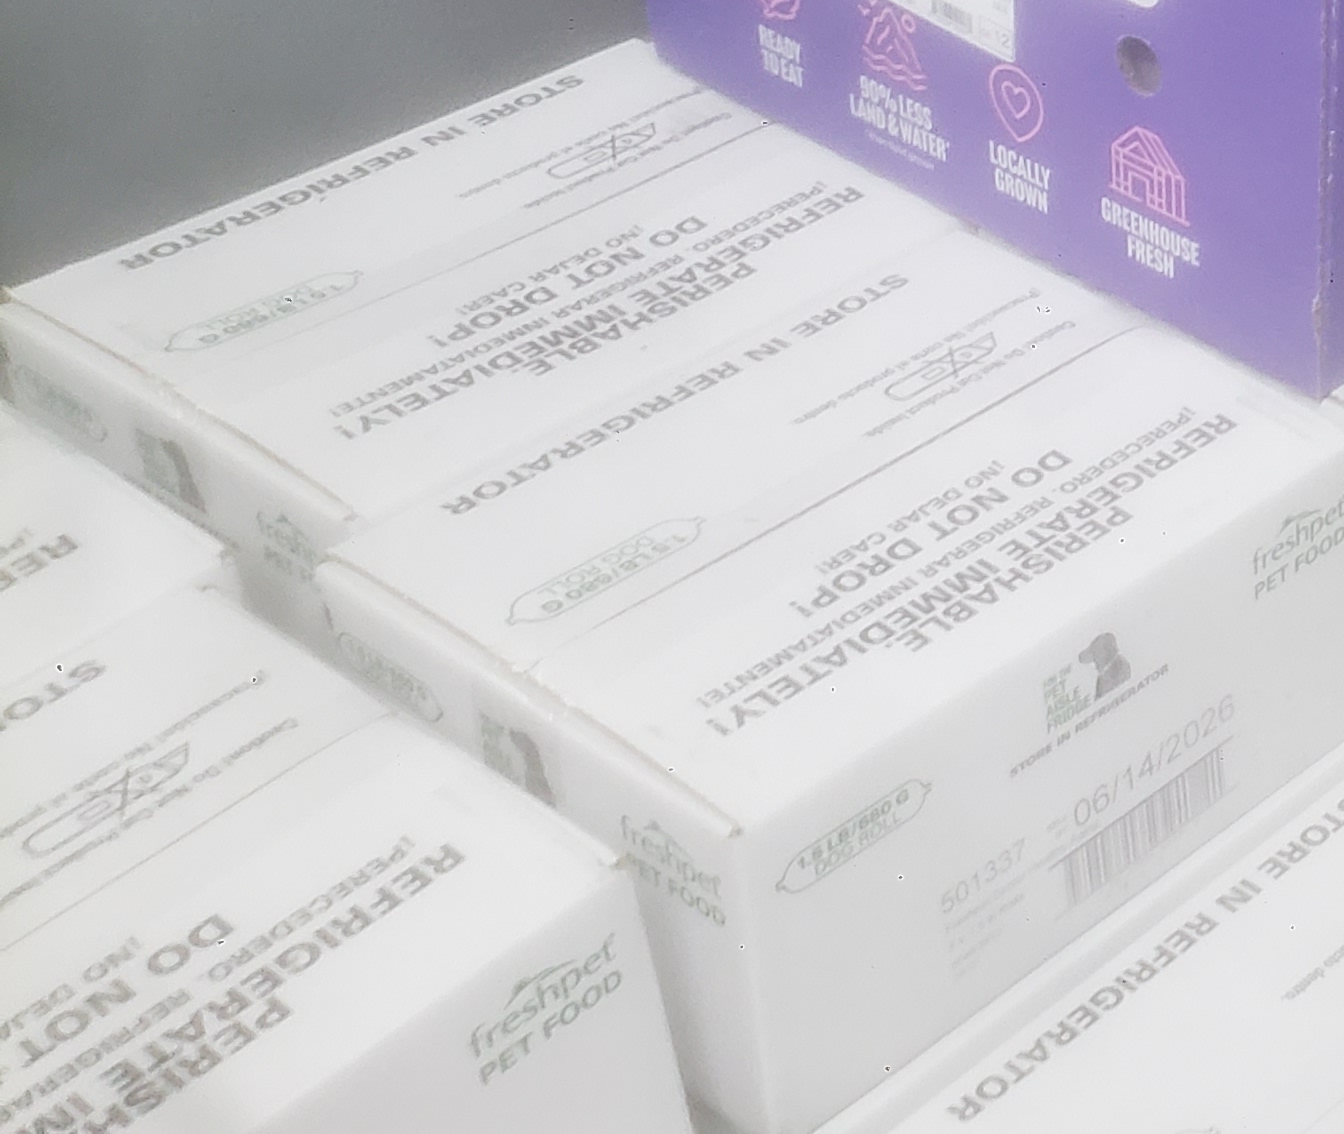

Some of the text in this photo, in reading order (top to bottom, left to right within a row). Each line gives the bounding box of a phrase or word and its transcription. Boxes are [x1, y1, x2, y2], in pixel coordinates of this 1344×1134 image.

[758, 24, 802, 65] READY
[761, 49, 804, 88] TO EAT
[850, 93, 887, 130] LAND
[887, 113, 899, 137] &
[898, 94, 933, 131] LESS
[119, 75, 584, 271] STORE IN REFRIGERATOR
[989, 140, 1050, 190] LOCALLY
[995, 168, 1048, 214] GROWN
[530, 248, 600, 282] DEJAR
[1101, 196, 1200, 266] GREENHOUSE
[1127, 234, 1174, 278] FRESH
[333, 185, 865, 442] REFRIGERATE IMMEDIATELY!
[426, 216, 708, 349] DO NOT DROP!
[454, 280, 526, 316] CAER!
[551, 253, 684, 319] REFRIGERAR
[511, 262, 757, 378] PERISHABLE.
[328, 317, 549, 417] INMEDIATAMENTE!
[440, 274, 909, 515] STORE IN REFRIGERATOR
[788, 448, 1074, 619] DO NOT DROP!
[886, 486, 962, 533] DEJAR
[918, 493, 1055, 579] REFRIGERAR
[565, 553, 654, 600] LB/680
[600, 535, 655, 565] DOG
[704, 412, 1239, 738] REFRIGERATE IMMEDIATELY!
[814, 531, 887, 576] CAER!
[882, 505, 1135, 653] PERISHABLE.
[1254, 563, 1289, 601] PET
[541, 599, 565, 614] G
[695, 576, 919, 710] INMEDIATAMENTE!
[0, 661, 107, 733] STO
[1009, 741, 1053, 778] STORE
[1056, 730, 1071, 746] IN
[1075, 663, 1170, 733] REFRIGERATOR
[1043, 679, 1067, 699] PET
[1046, 685, 1081, 719] AISLE
[1046, 695, 1092, 735] FRIDGE
[1073, 693, 1236, 827] 06/14/2026
[895, 788, 910, 806] G
[940, 837, 1026, 915] 501337
[1214, 876, 1263, 915] IN
[16, 913, 236, 1069] DO NOT
[100, 842, 467, 1096] REFRIGERATE
[468, 931, 617, 1059] freshpet
[479, 969, 623, 1086] PET FOOD
[944, 911, 1220, 1124] REFRIGERATOR
